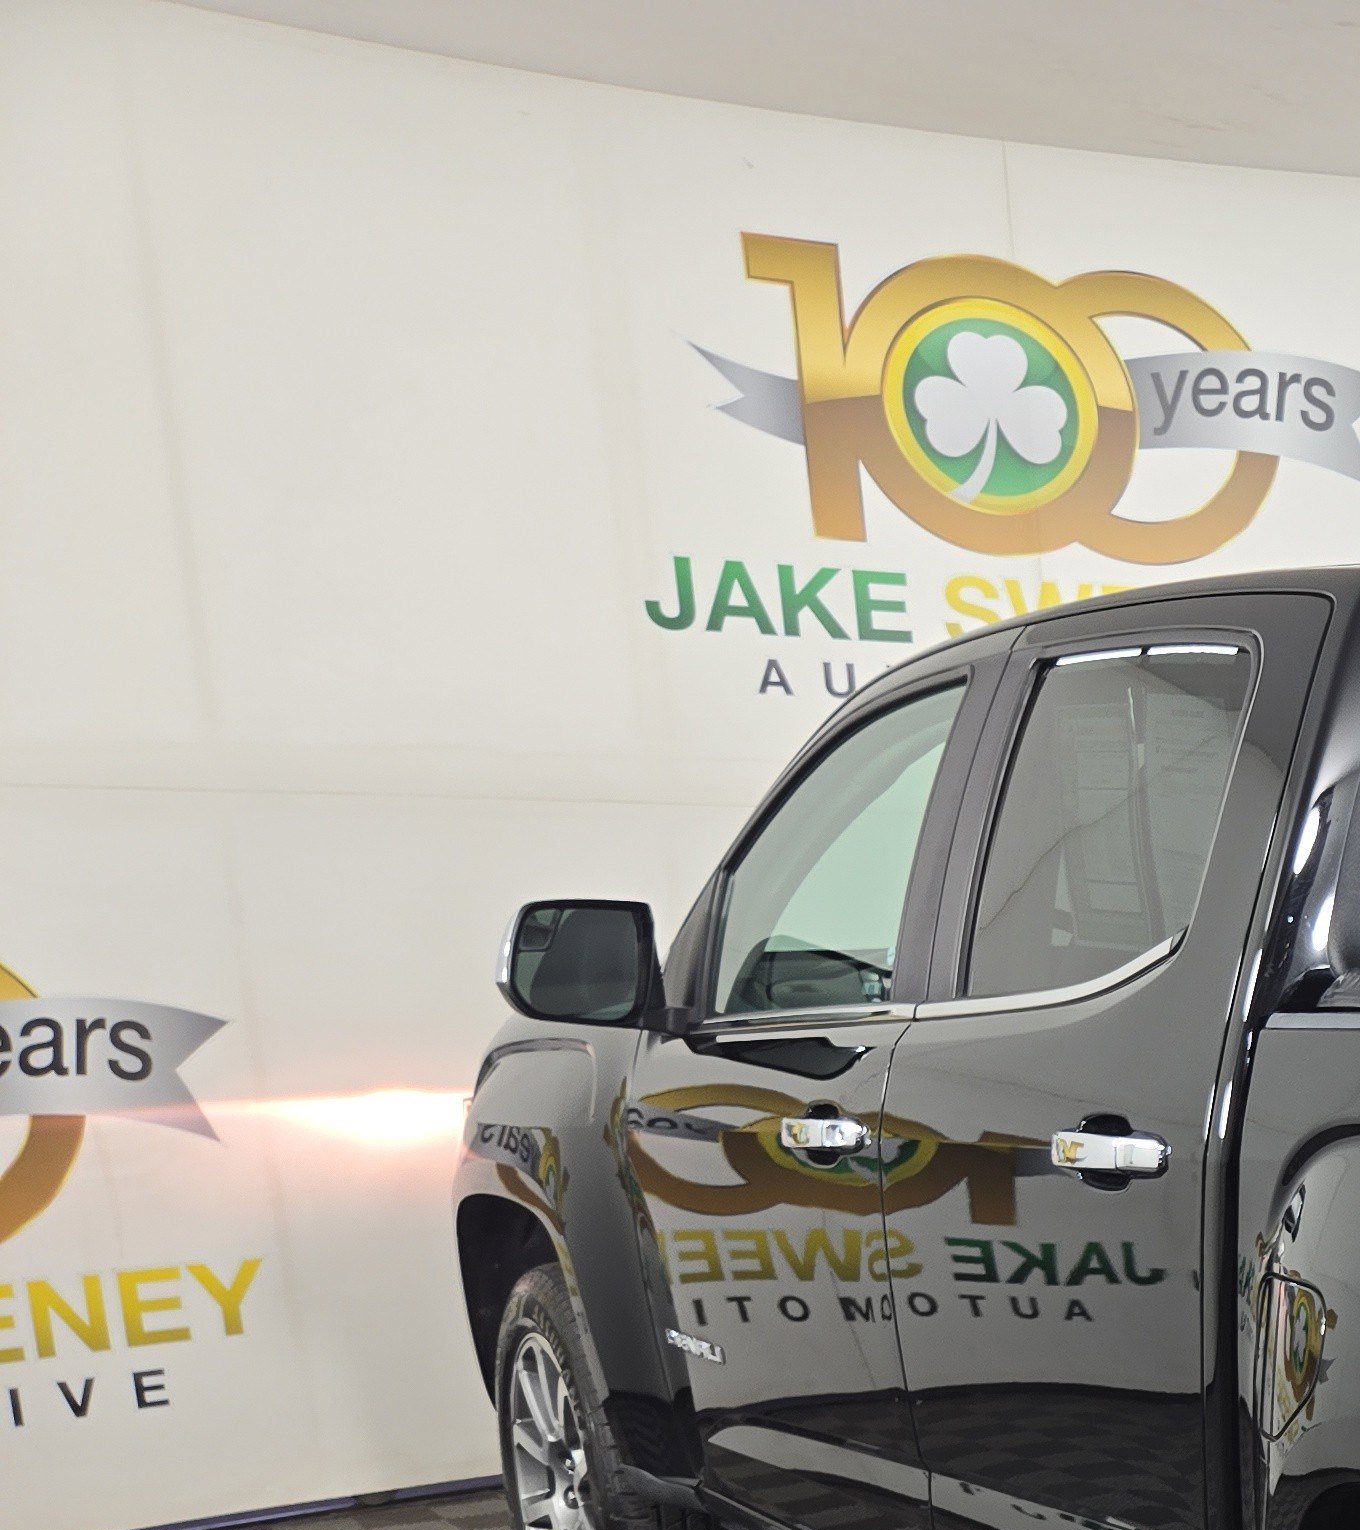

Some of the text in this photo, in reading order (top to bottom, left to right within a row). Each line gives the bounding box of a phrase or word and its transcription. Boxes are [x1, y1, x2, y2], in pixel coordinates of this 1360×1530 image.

[740, 231, 1337, 566] 100 years
[645, 556, 913, 644] JAKE
[0, 1017, 154, 1081] ars
